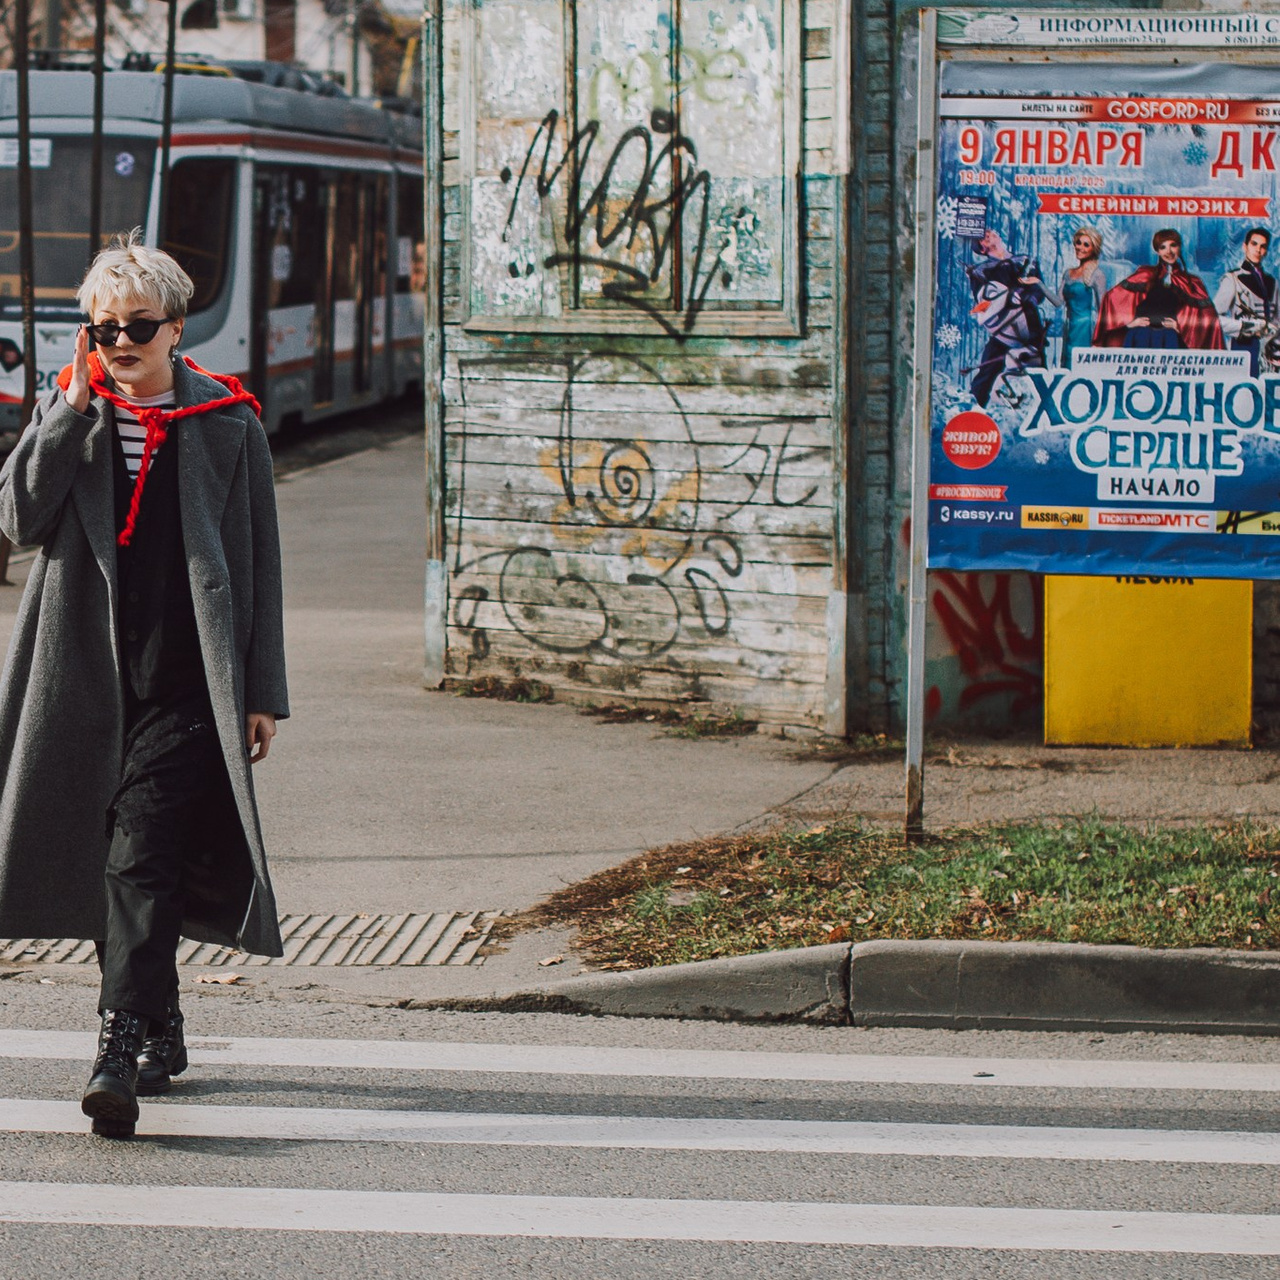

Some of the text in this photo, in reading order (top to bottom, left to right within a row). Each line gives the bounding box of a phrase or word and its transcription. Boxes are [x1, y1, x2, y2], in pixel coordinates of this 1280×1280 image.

[1040, 13, 1258, 35] ИНФОРМАЦИОННЫЙ
[1021, 103, 1094, 113] БИЛЕТЫ НА САЙТЕ
[960, 128, 981, 164] 9
[993, 129, 1143, 166] ЯНВАРЯ
[959, 170, 996, 186] 19:00
[1058, 195, 1249, 214] СЕМЕЙНЫЙ МЮЗИКЛ
[1076, 353, 1245, 367] УДИВИТЕЛЬНОЕ ПРЕДСТАВЛЕНИЕ
[1116, 365, 1205, 377] ДЛЯ ВСЕЙ СЕМЬИ
[943, 430, 999, 444] ЖИВОЙ
[950, 444, 992, 456] ЗВУК!
[1076, 425, 1238, 475] СЕРДЦЕ
[1110, 477, 1201, 497] НАЧАЛО
[953, 509, 1014, 522] kassy.ru
